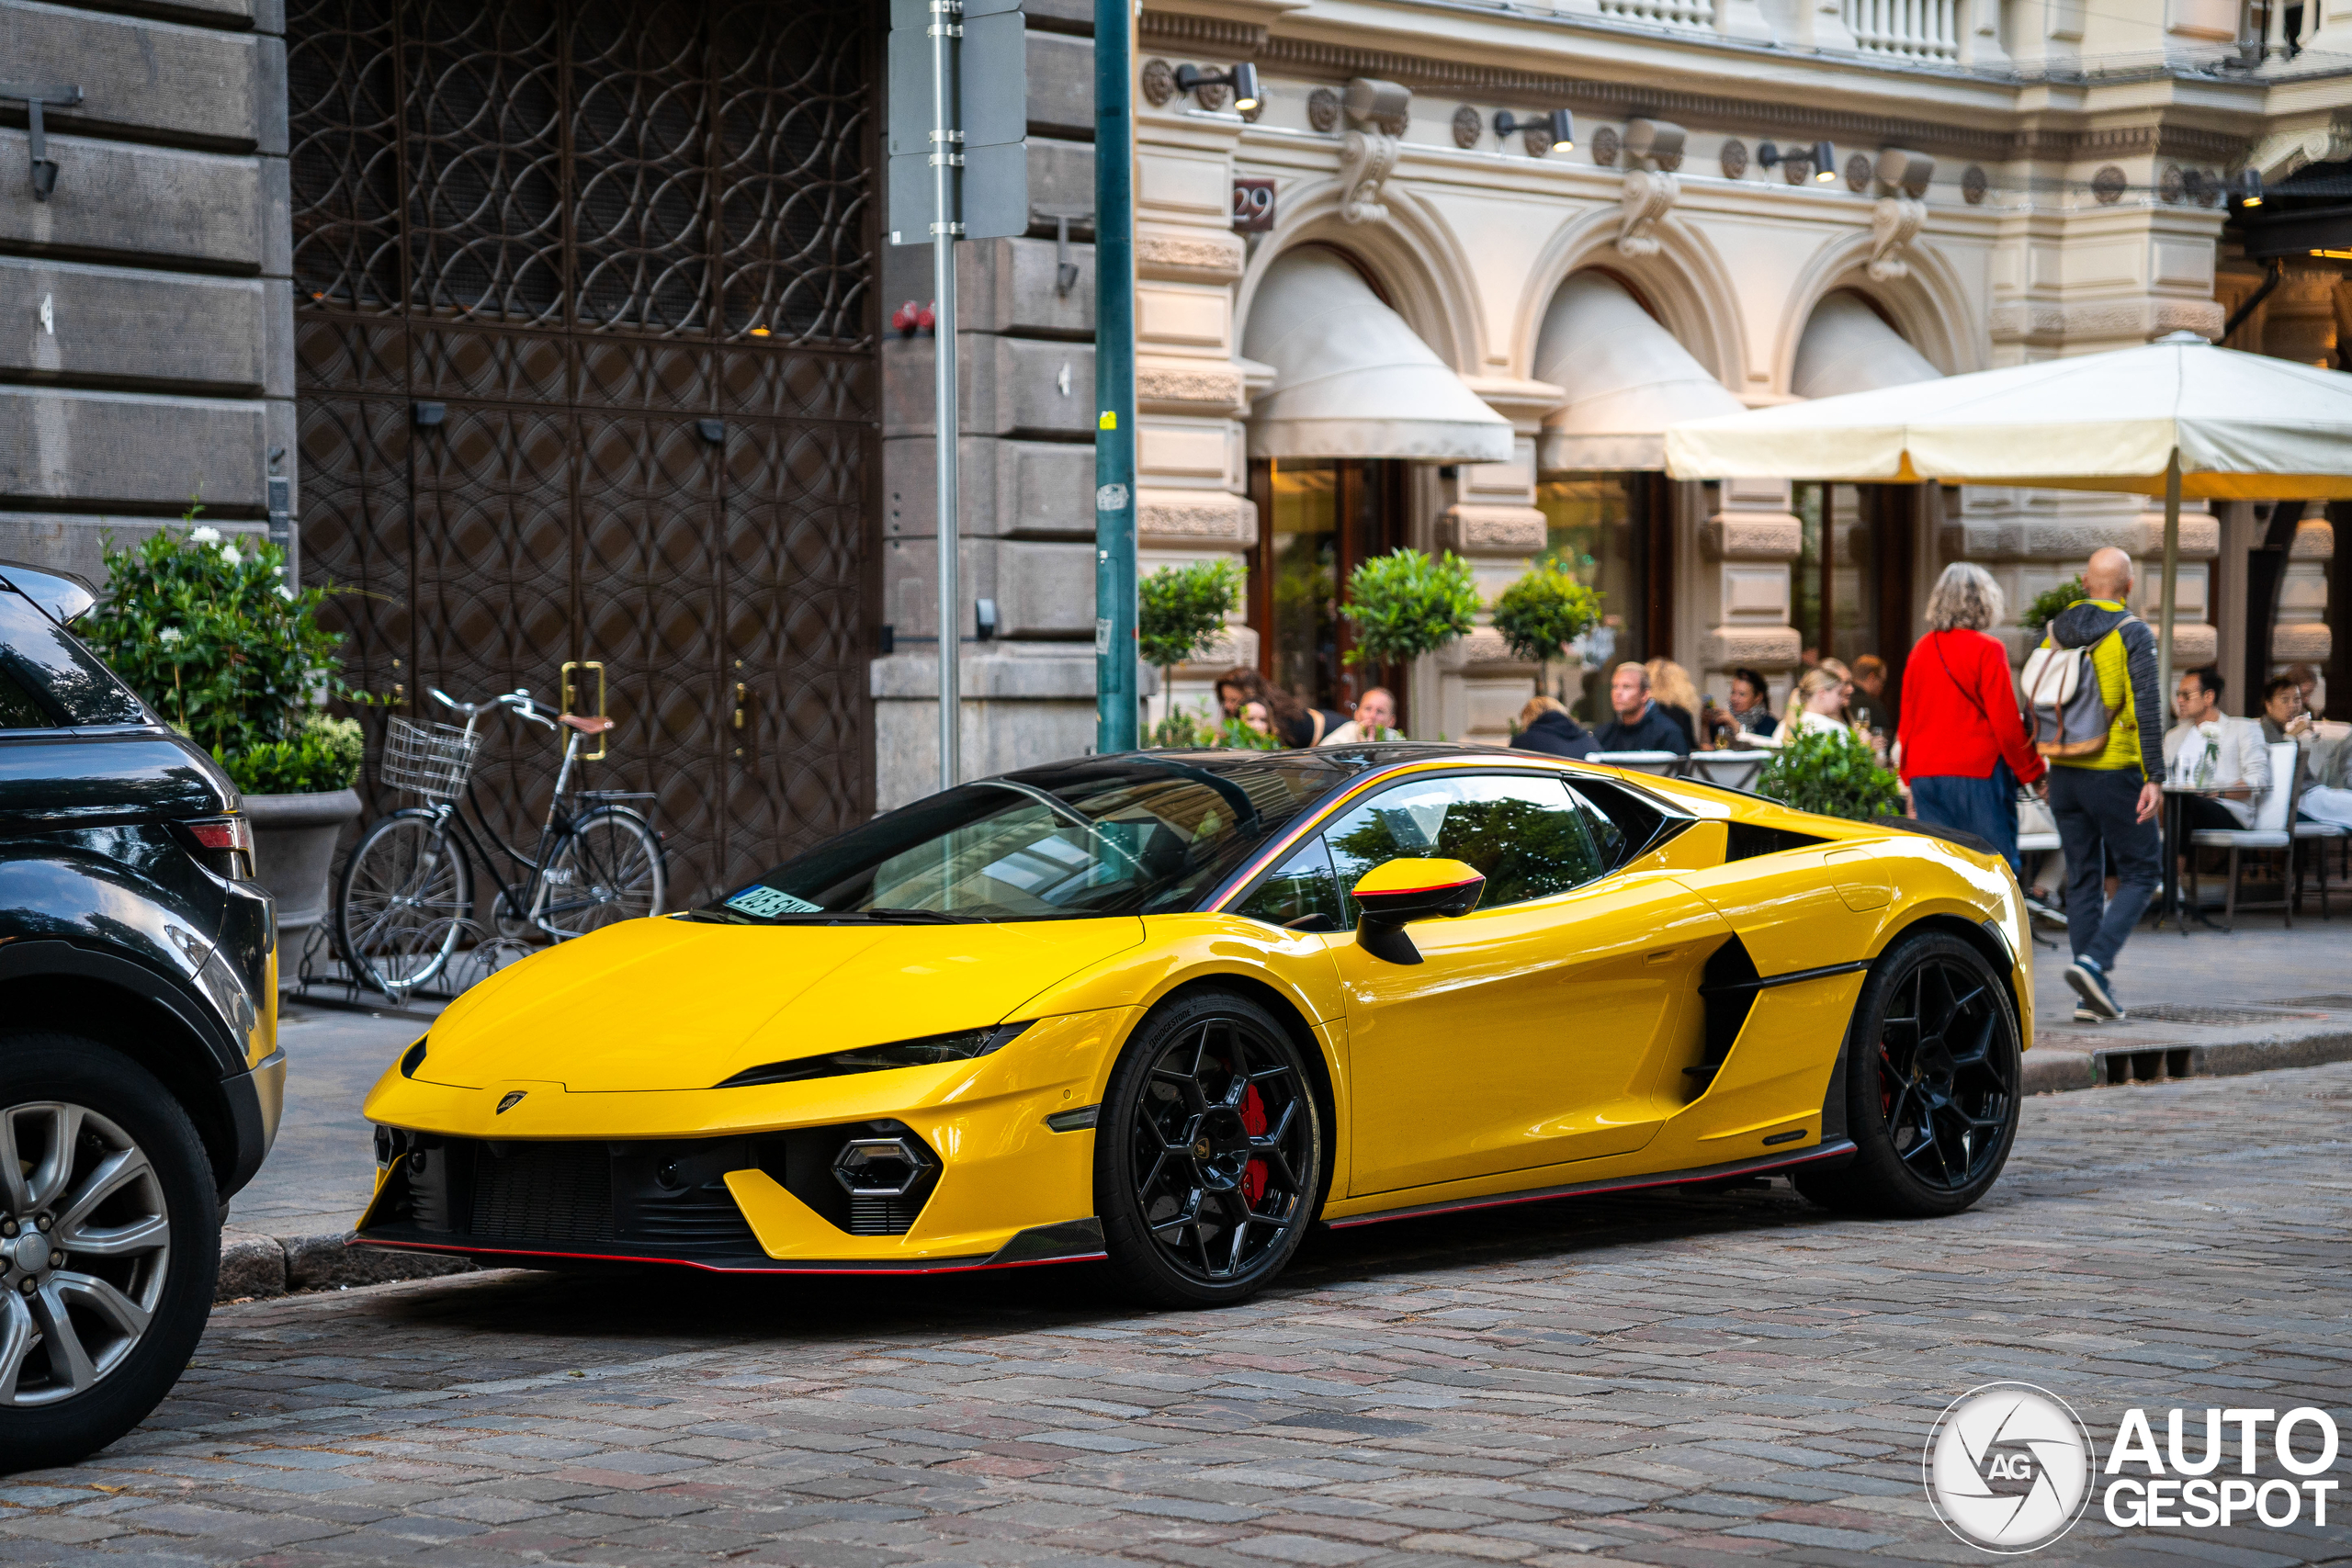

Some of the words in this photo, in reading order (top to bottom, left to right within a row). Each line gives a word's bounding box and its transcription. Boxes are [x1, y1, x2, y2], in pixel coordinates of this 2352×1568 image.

[1233, 186, 1273, 221] 29
[734, 890, 781, 908] 245
[1148, 1009, 1192, 1050] BRIDGESTONE
